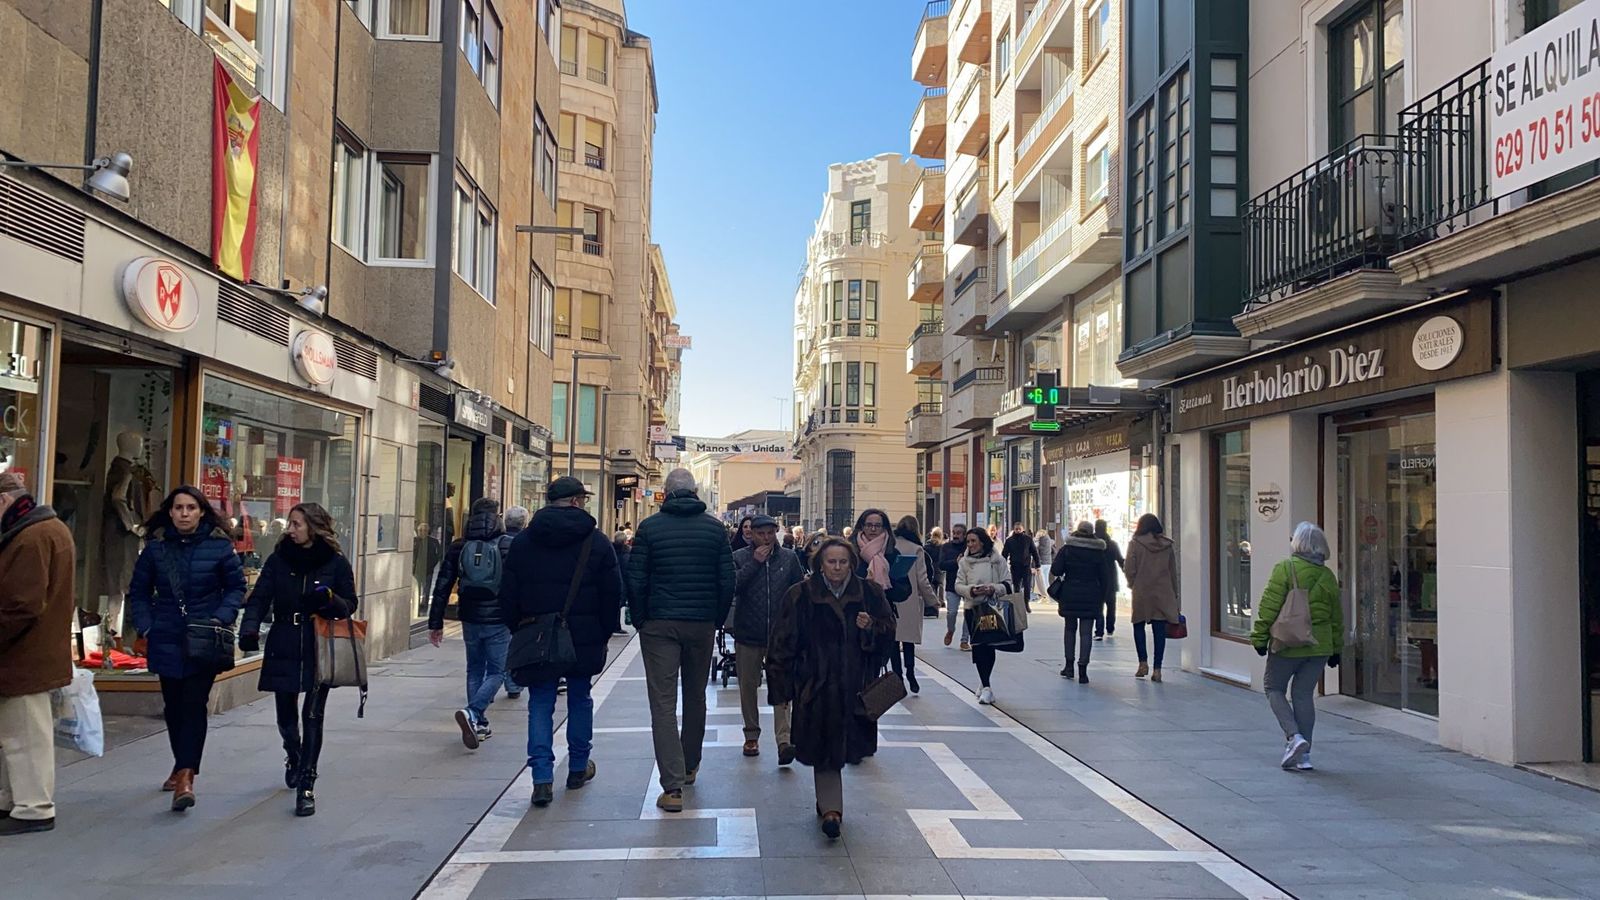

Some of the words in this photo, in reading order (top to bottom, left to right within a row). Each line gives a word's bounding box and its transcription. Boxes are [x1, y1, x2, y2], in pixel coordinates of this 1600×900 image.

[1495, 62, 1517, 117] SE
[1520, 17, 1600, 105] ALQUILA
[1495, 128, 1524, 179] 629
[1528, 116, 1549, 165] 70
[1554, 103, 1573, 155] 51
[1581, 91, 1600, 144] 50
[159, 286, 165, 299] R
[171, 291, 179, 305] M
[1417, 327, 1456, 343] SOLUCIONES
[1418, 336, 1454, 351] NATURALES
[1419, 348, 1439, 360] DESDE
[1222, 356, 1325, 411] Herbolario
[1328, 344, 1384, 388] Diez
[696, 444, 730, 453] Manos
[752, 444, 785, 453] Unidas
[279, 461, 302, 473] REBAJAS
[1067, 468, 1097, 486] ZAMORA
[277, 486, 300, 498] REBAJAS
[1069, 490, 1084, 505] IBRE
